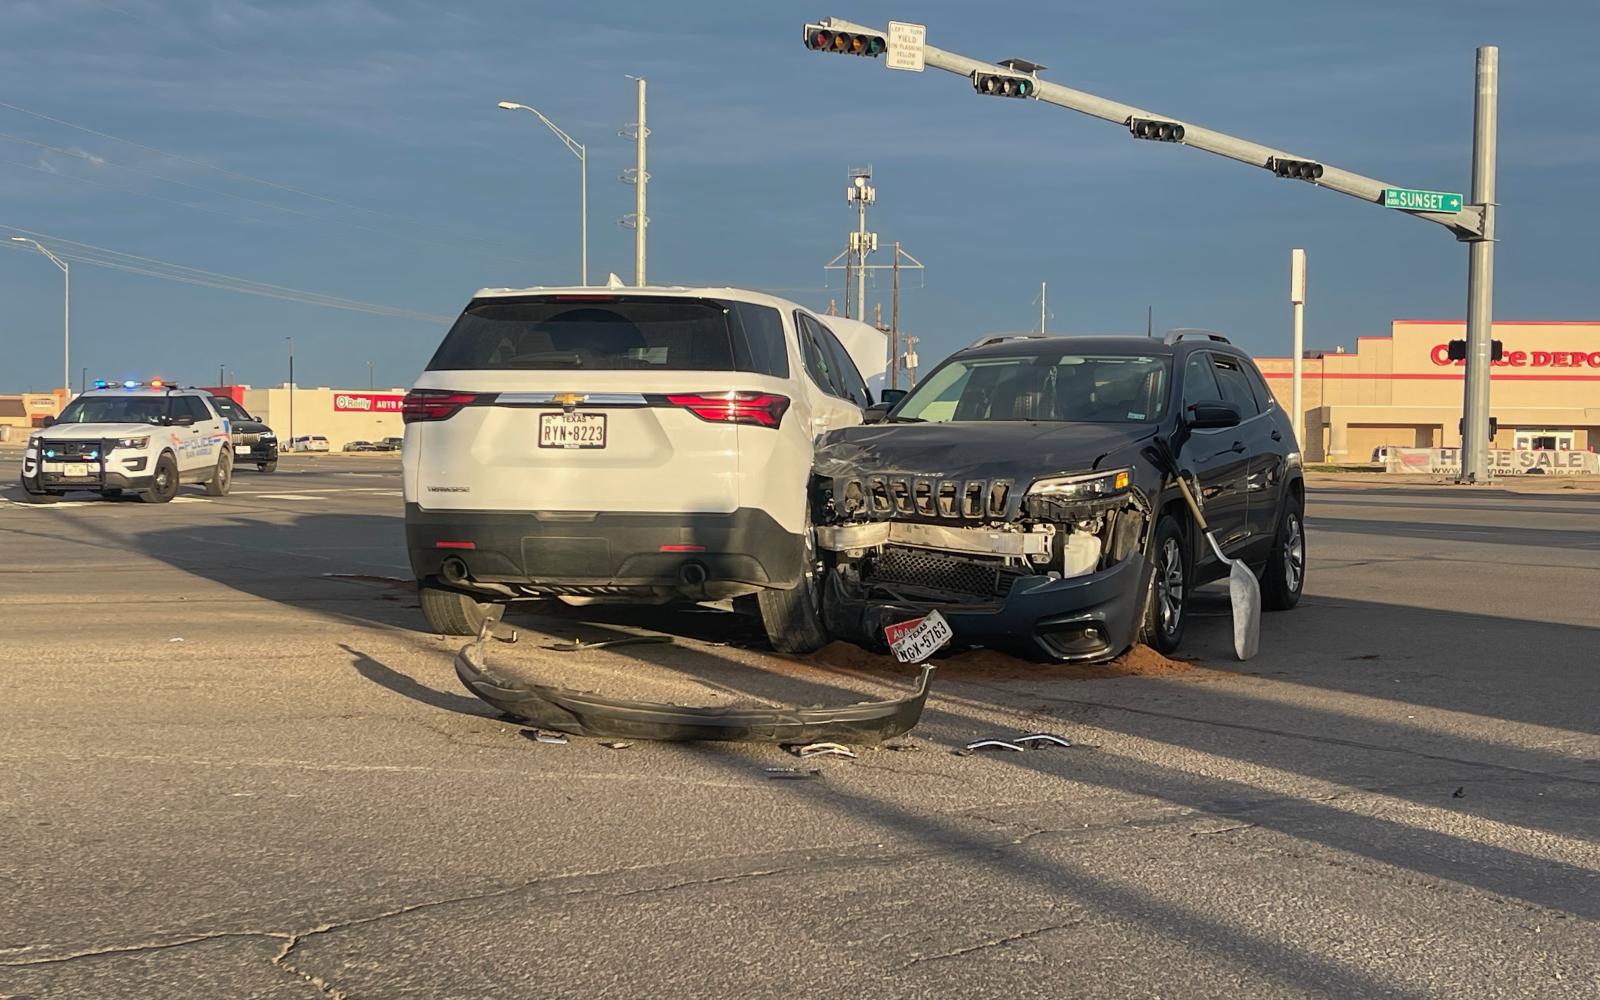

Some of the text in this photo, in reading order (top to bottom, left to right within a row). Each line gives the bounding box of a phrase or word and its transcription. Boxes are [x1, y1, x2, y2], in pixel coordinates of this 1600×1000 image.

[898, 33, 917, 44] YIELD
[1400, 191, 1444, 208] SUNSET
[1430, 344, 1527, 367] Oce
[336, 396, 372, 410] O'Reilly
[377, 400, 396, 409] AUTO
[562, 415, 586, 423] TEXAS
[1440, 450, 1583, 468] HGE SALE
[909, 622, 928, 640] TEXAS
